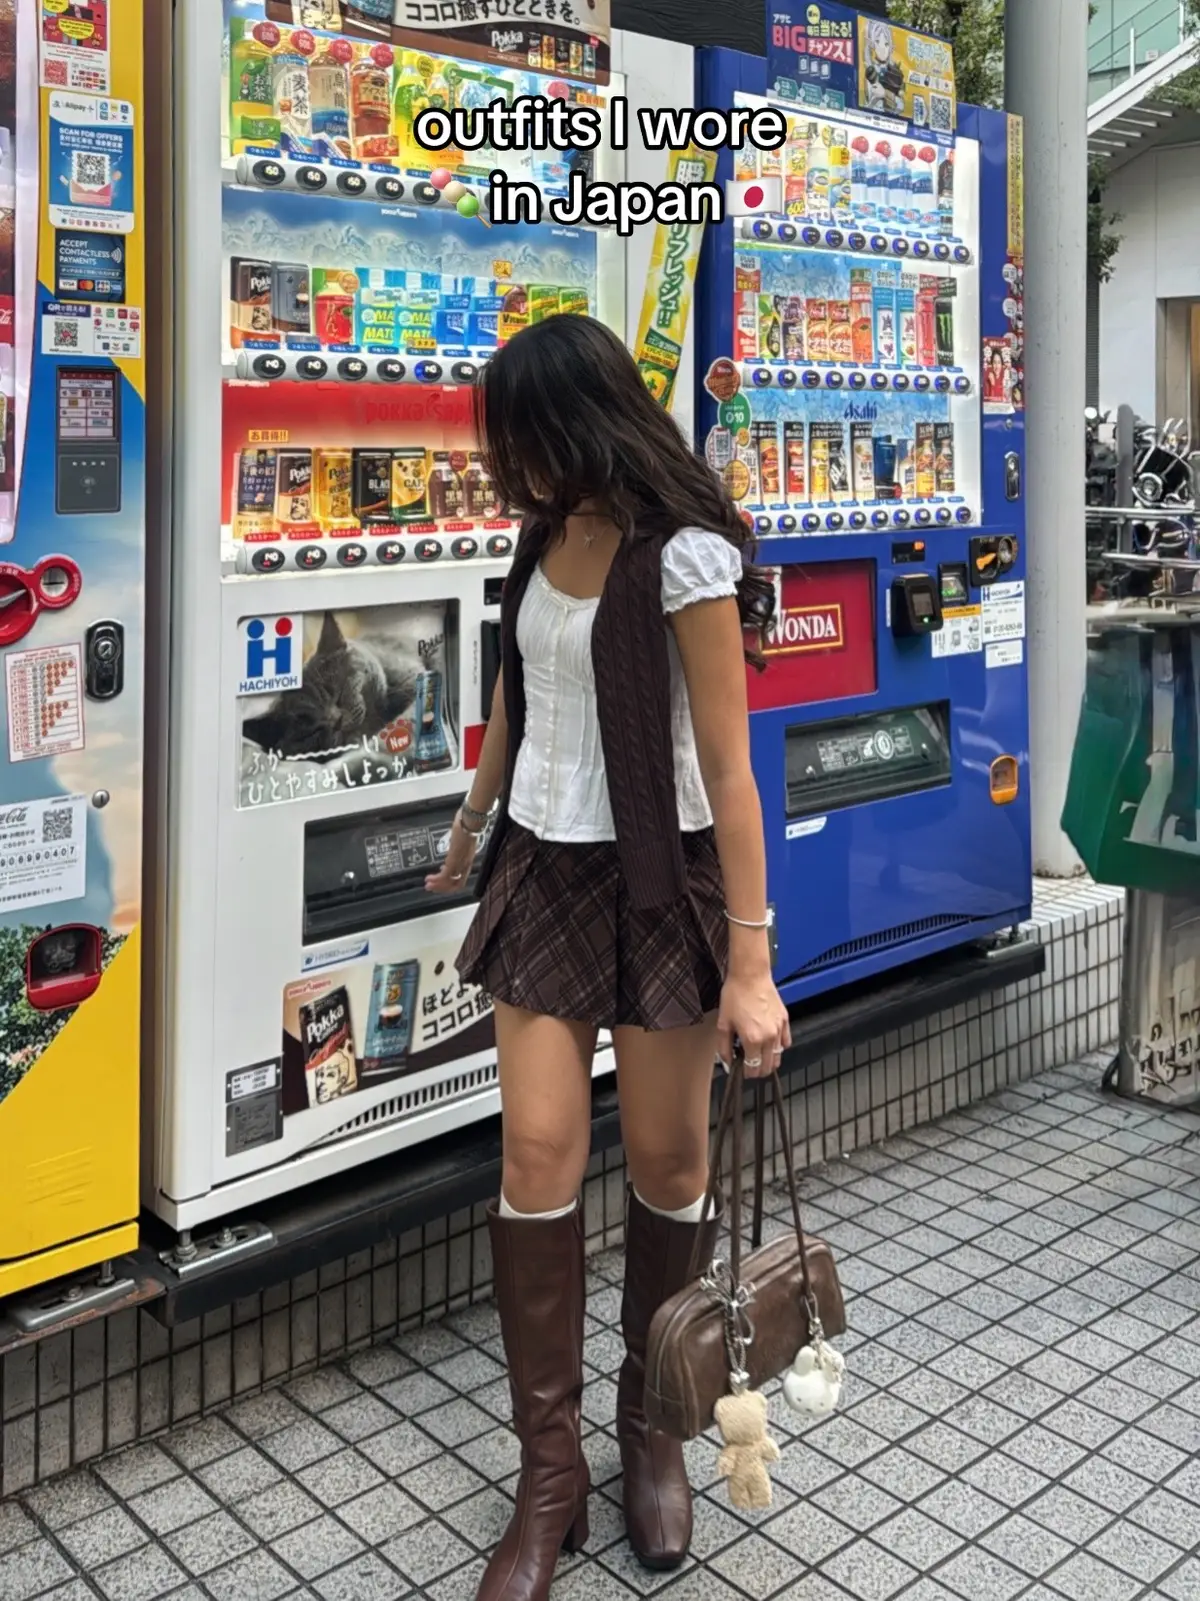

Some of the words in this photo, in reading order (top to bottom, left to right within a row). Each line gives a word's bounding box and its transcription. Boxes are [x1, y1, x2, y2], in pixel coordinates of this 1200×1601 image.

[405, 0, 580, 25] ココロ癒すひとときを。
[773, 13, 791, 23] アサヒ
[491, 31, 524, 46] Pokka
[773, 25, 806, 53] BIG
[808, 39, 852, 64] チャンス!
[293, 74, 308, 115] 麦茶
[59, 127, 80, 136] SCAN
[80, 130, 96, 138] FOR
[96, 132, 123, 142] OFFERS
[59, 239, 89, 248] ACCEPT
[59, 247, 111, 258] CONTACTLESS
[59, 256, 97, 266] PAYMENTS
[843, 400, 878, 420] Asahi
[767, 609, 838, 645] WONDA
[238, 676, 299, 693] HACHIYOH
[389, 735, 409, 750] New
[306, 1003, 345, 1044] Pokka
